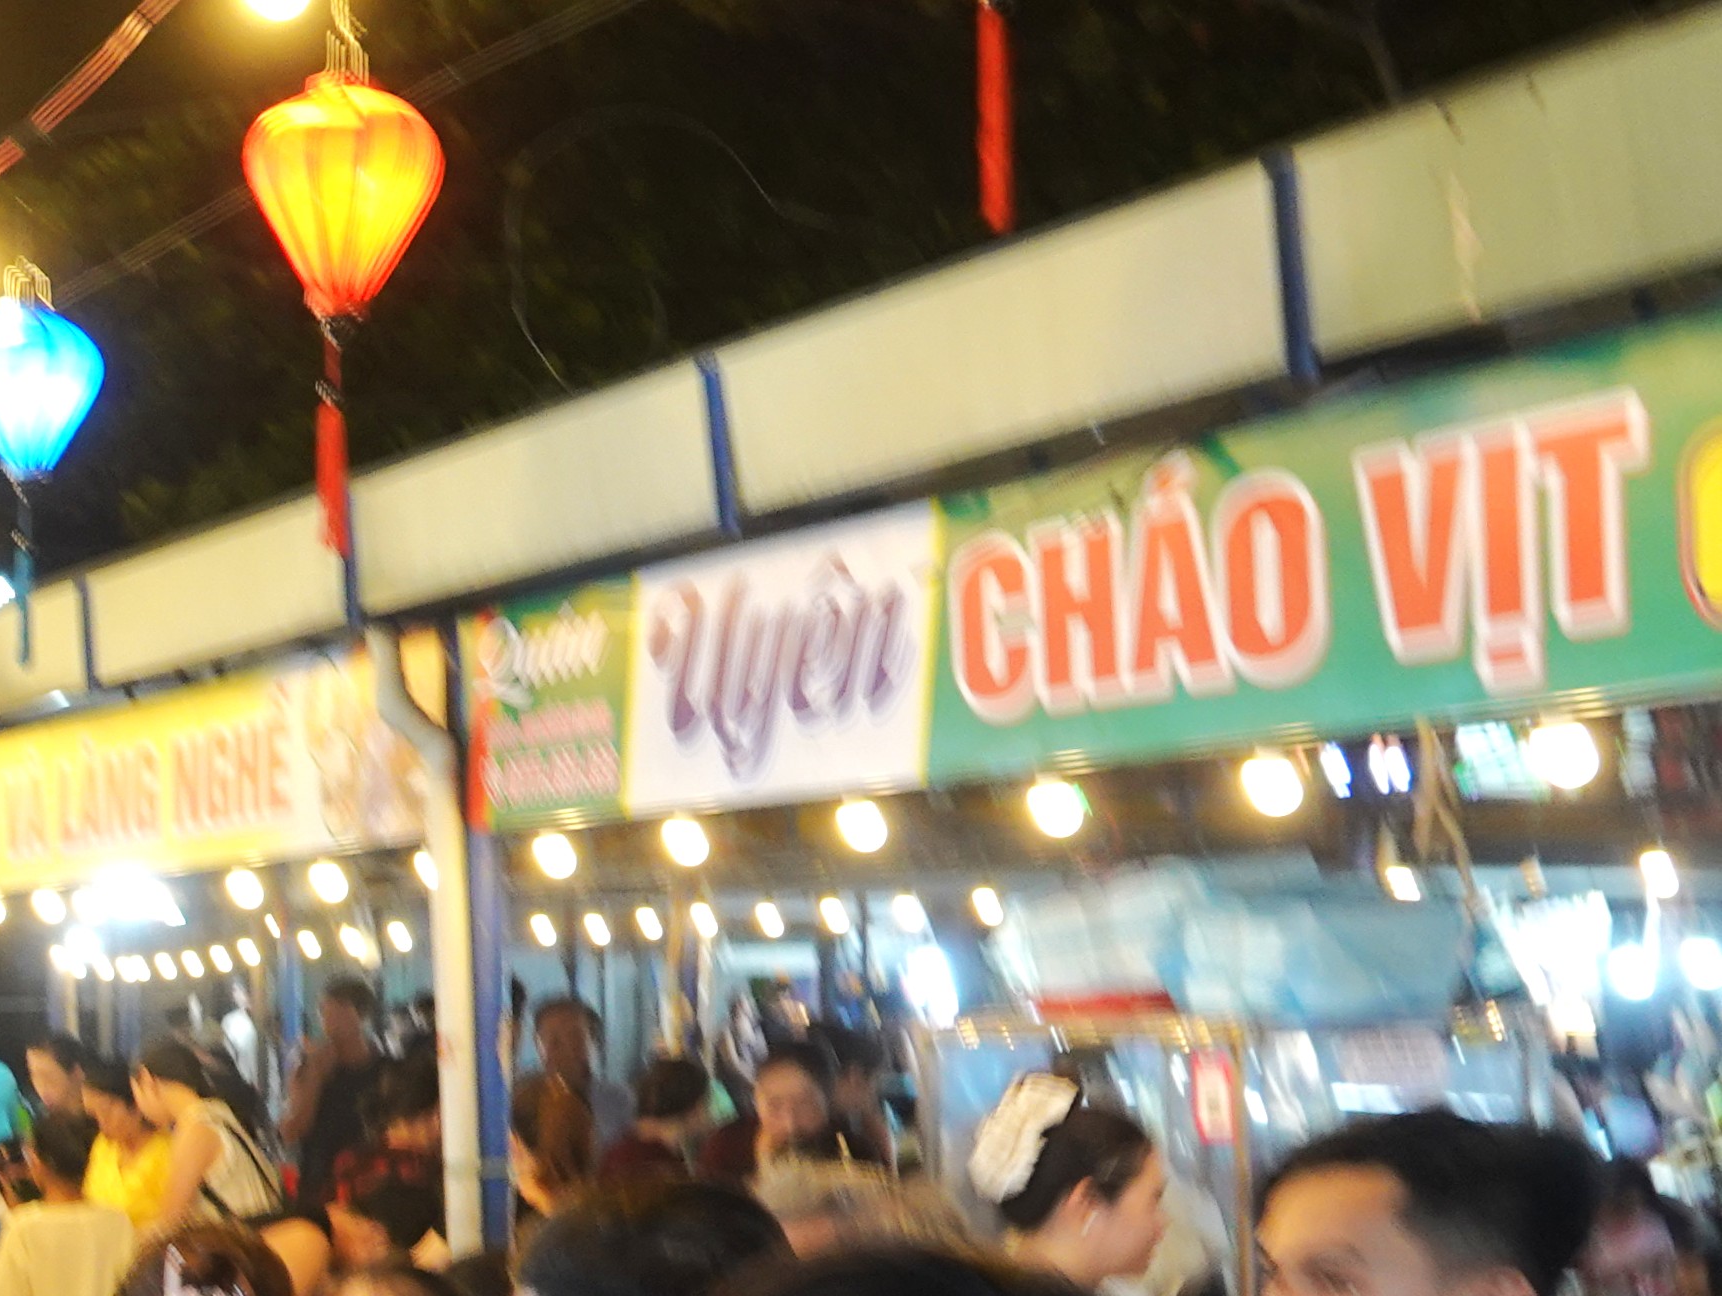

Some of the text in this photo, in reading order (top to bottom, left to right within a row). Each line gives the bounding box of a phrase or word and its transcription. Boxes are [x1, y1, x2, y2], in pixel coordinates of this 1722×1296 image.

[646, 550, 918, 784] Uyên
[946, 452, 1334, 728] CHÁO
[1353, 387, 1651, 698] VỊT
[168, 678, 294, 836] NGHỀ
